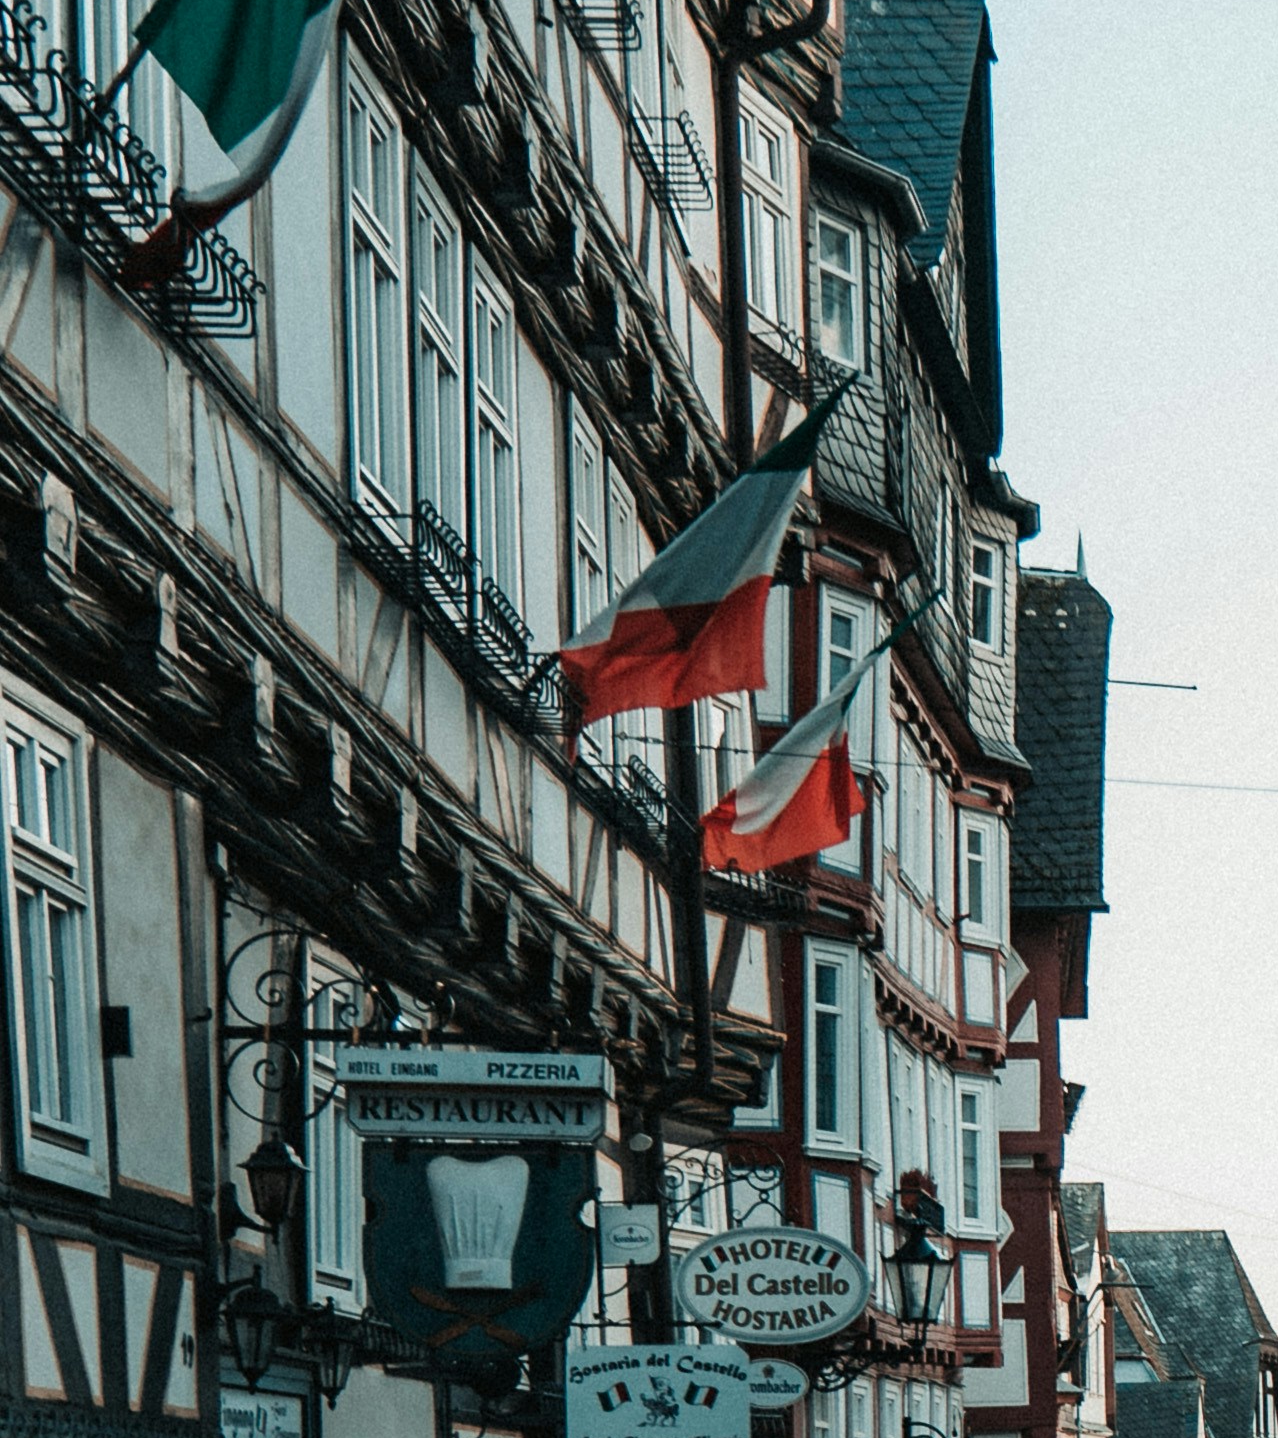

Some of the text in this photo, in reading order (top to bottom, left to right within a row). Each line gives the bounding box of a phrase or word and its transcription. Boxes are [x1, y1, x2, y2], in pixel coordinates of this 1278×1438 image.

[348, 1061, 438, 1077] HOTEL EINGANG
[487, 1062, 580, 1081] PIZZERIA
[358, 1094, 594, 1126] RESTAURANT
[728, 1238, 812, 1266] HOTEL
[694, 1272, 850, 1296] Del Castello
[712, 1299, 837, 1331] HOSTARIA
[569, 1354, 747, 1384] Hostaria del Castello
